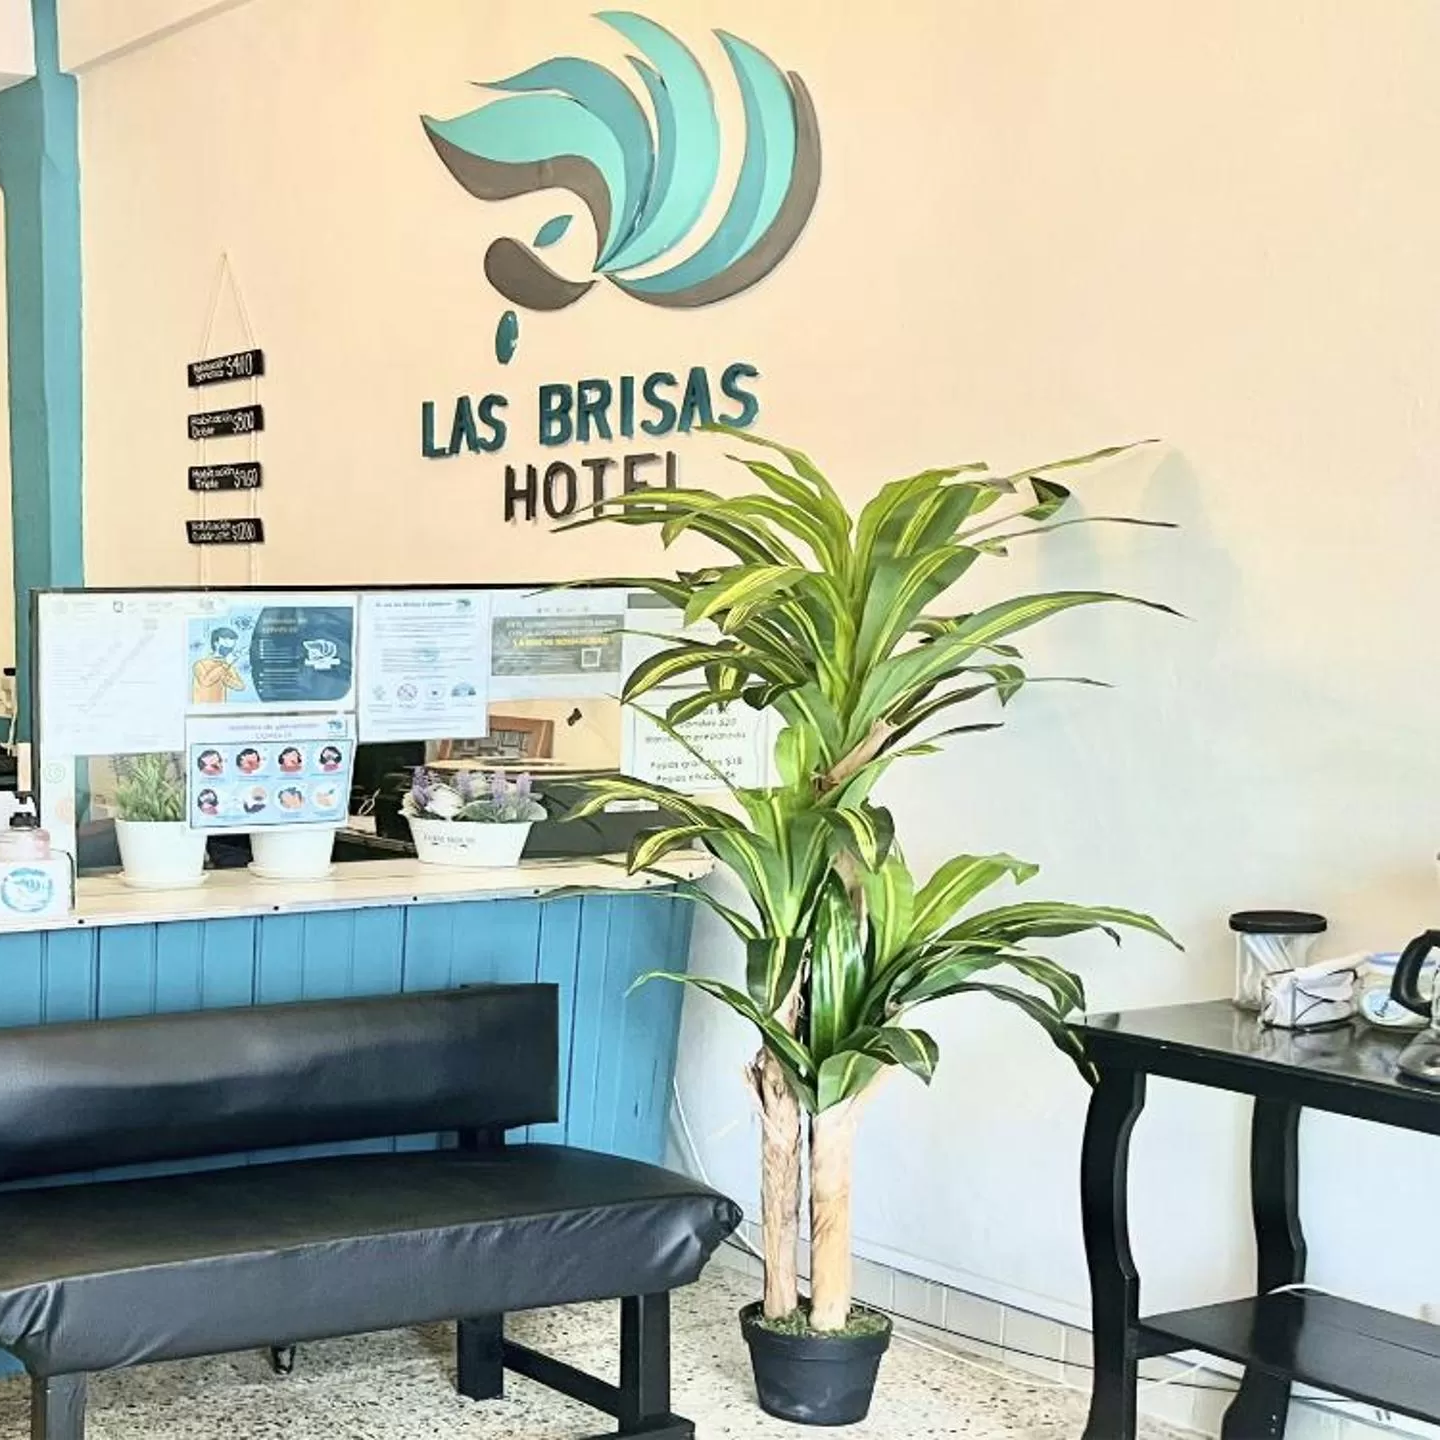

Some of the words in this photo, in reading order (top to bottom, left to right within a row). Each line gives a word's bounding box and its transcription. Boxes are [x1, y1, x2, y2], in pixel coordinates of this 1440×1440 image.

[421, 393, 509, 459] LAS
[538, 362, 760, 446] BRISAS
[503, 450, 680, 523] HOTEL
